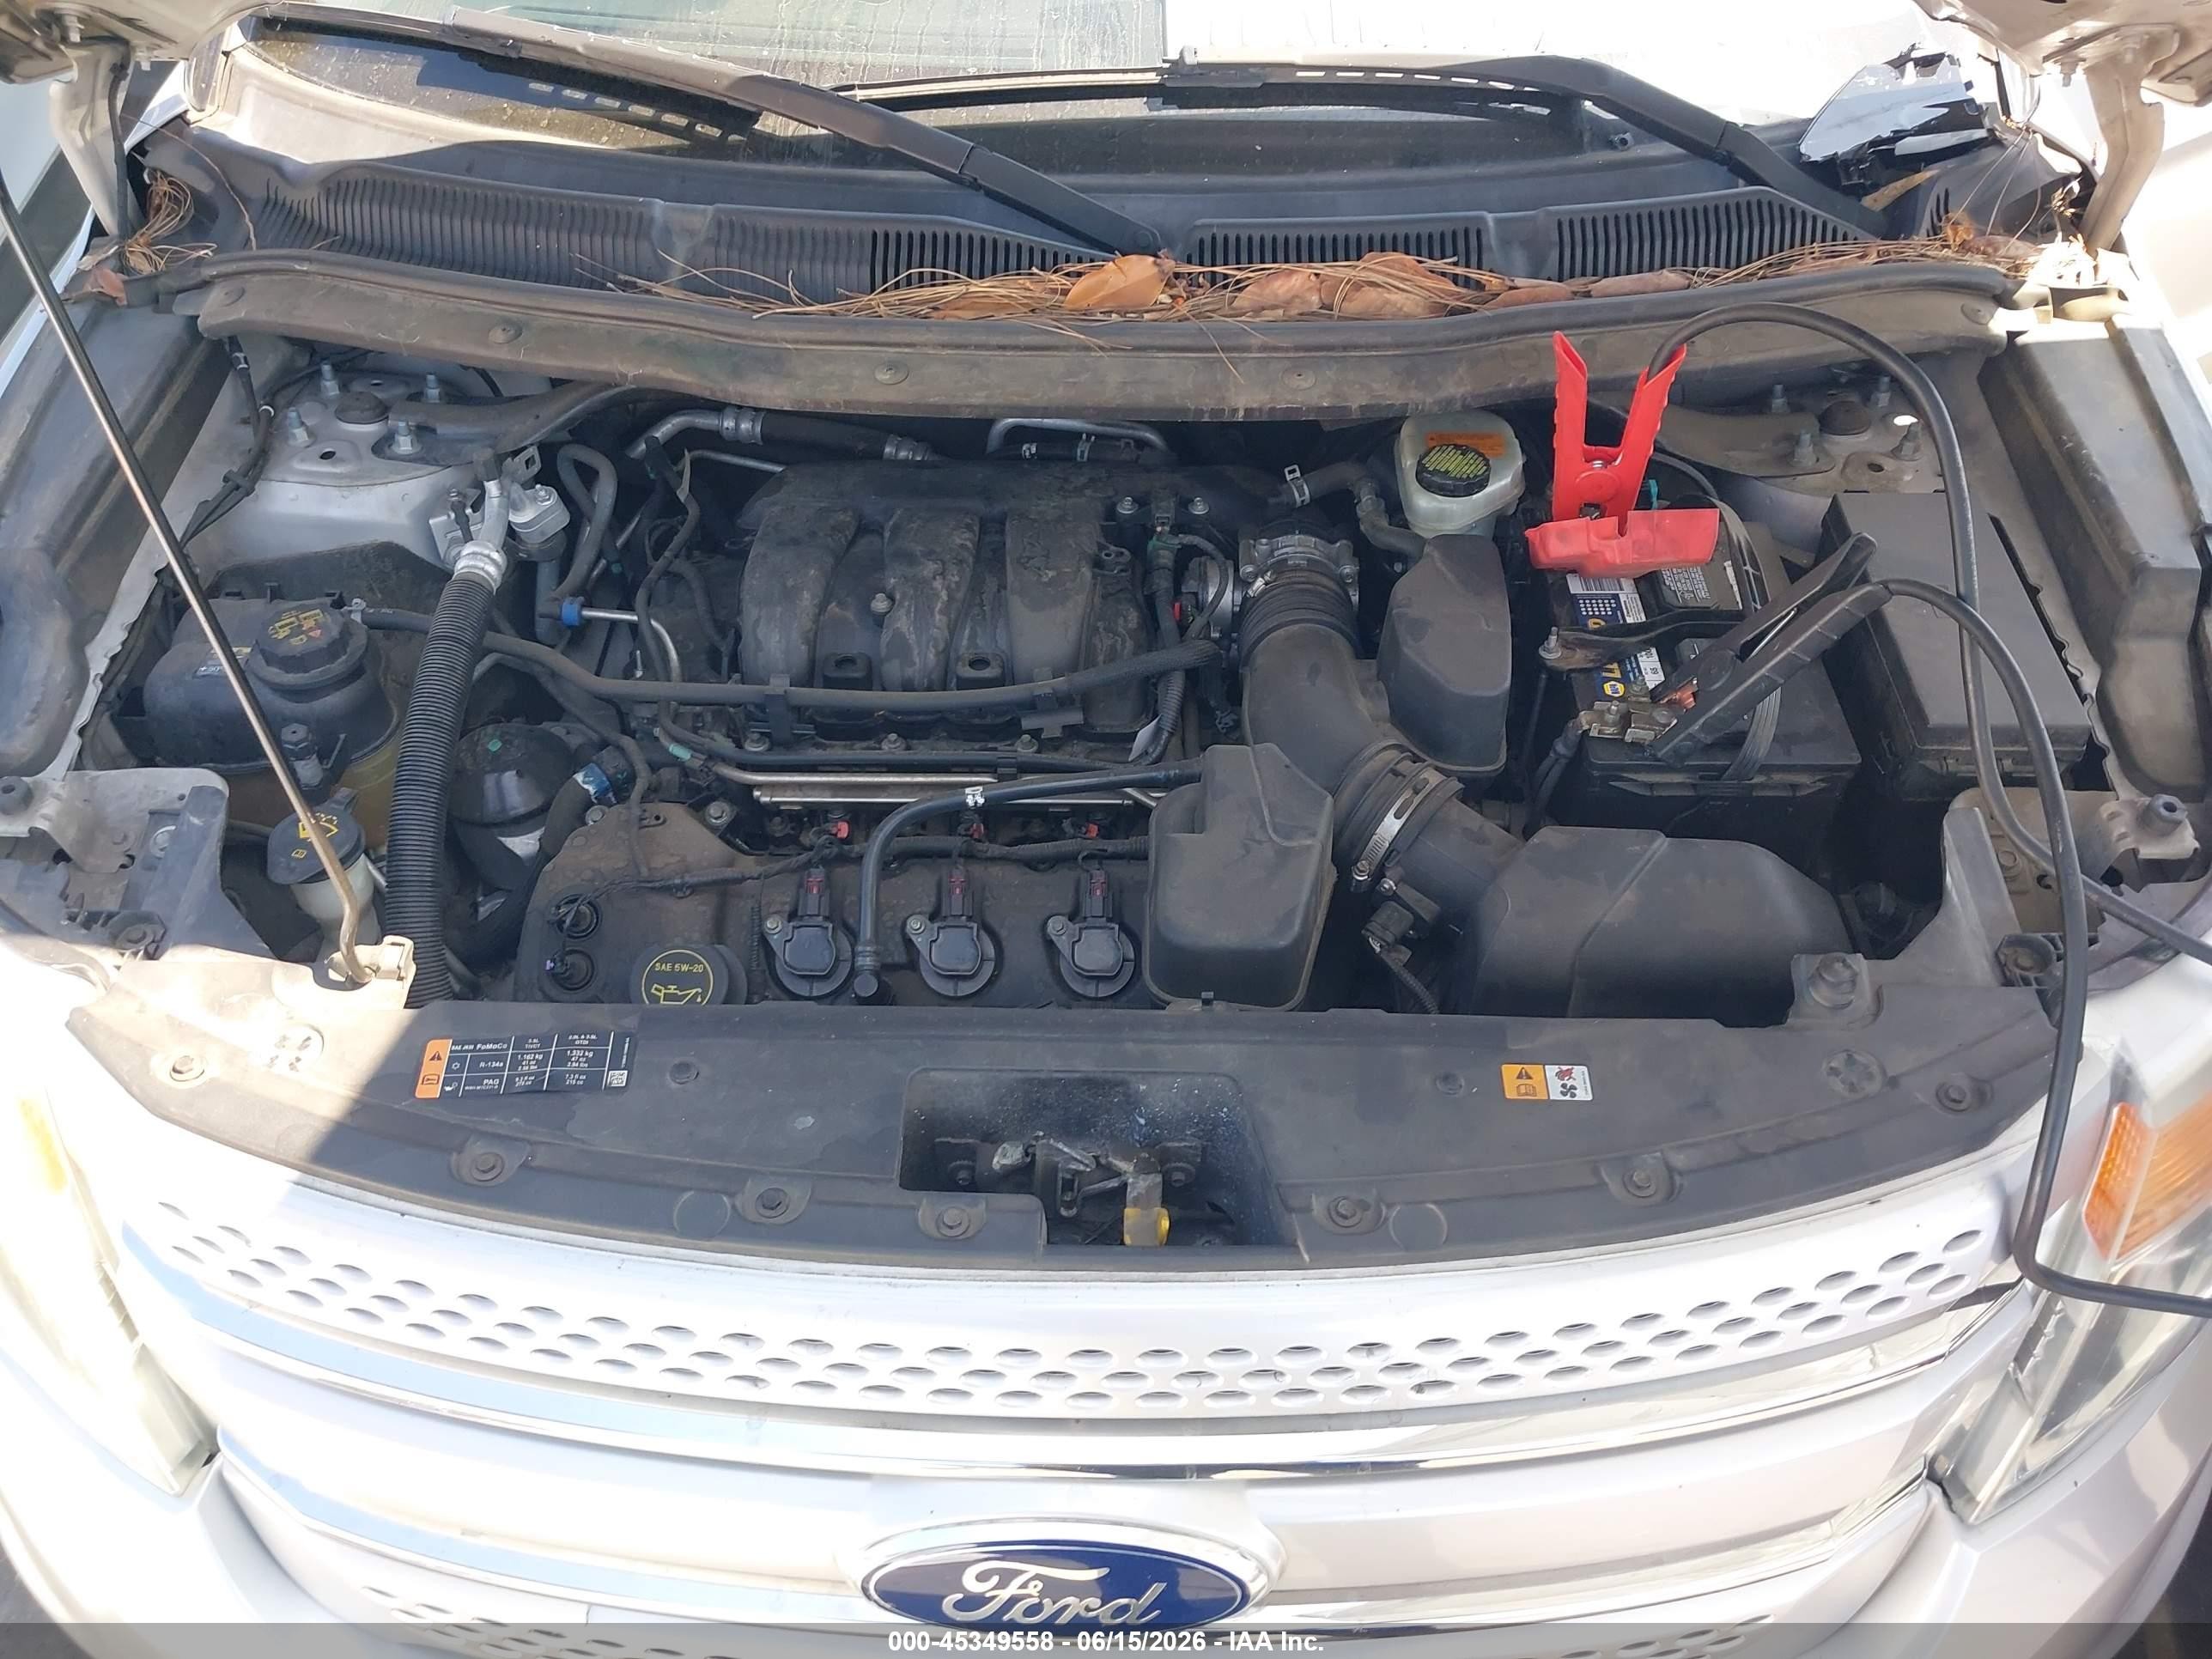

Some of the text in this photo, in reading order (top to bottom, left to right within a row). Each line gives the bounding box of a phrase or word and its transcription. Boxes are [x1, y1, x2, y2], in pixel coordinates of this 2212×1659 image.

[654, 962, 704, 973] SAE 5W-20
[584, 1049, 594, 1058] kg
[942, 1559, 1168, 1626] Ford
